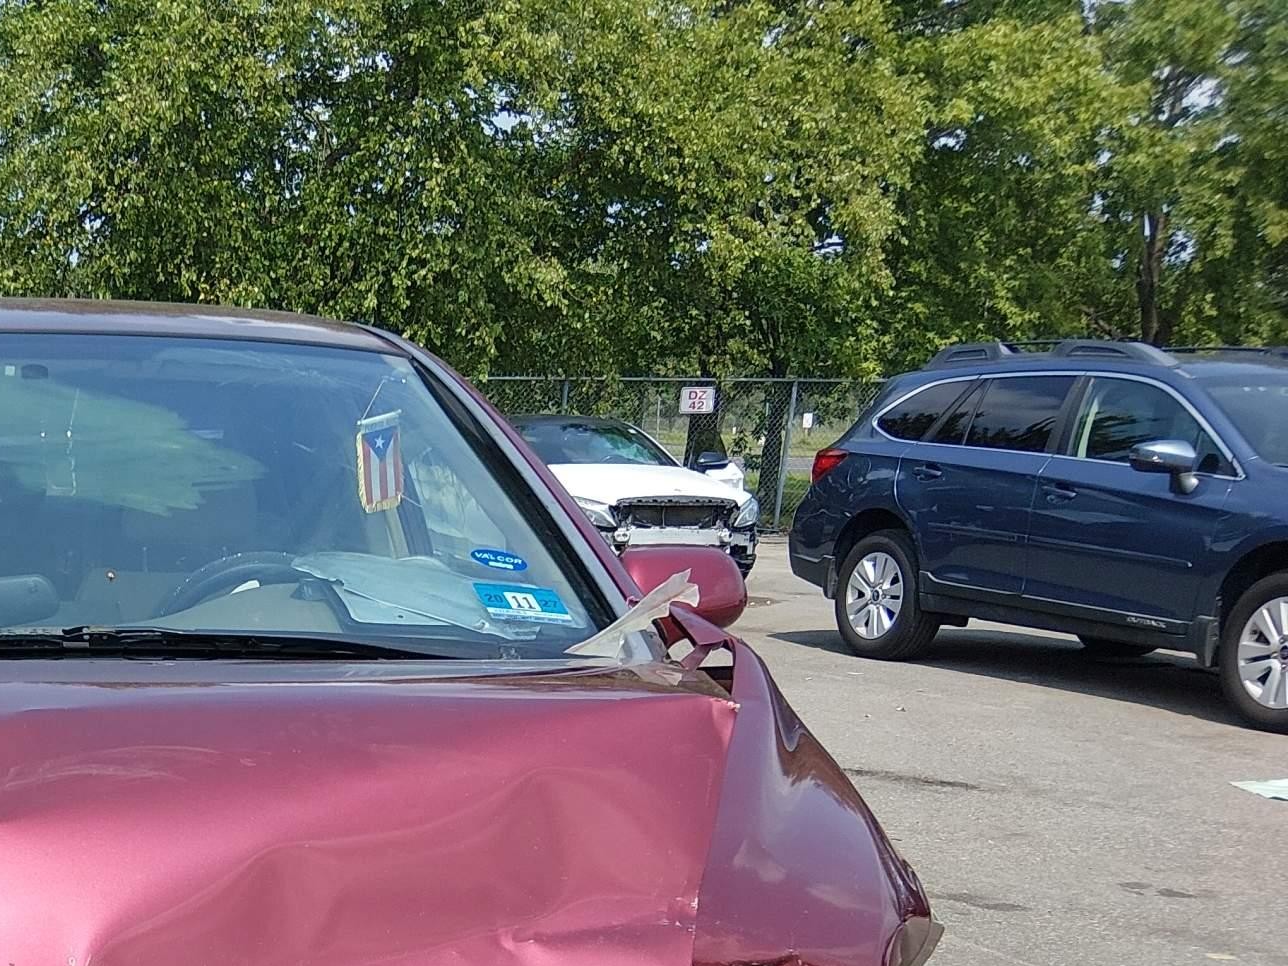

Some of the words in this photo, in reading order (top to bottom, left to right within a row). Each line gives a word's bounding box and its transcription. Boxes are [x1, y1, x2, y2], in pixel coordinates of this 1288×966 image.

[688, 390, 708, 400] DZ
[688, 400, 705, 410] 42
[474, 551, 523, 565] VALCOR
[484, 593, 504, 603] 20
[511, 595, 537, 610] 11
